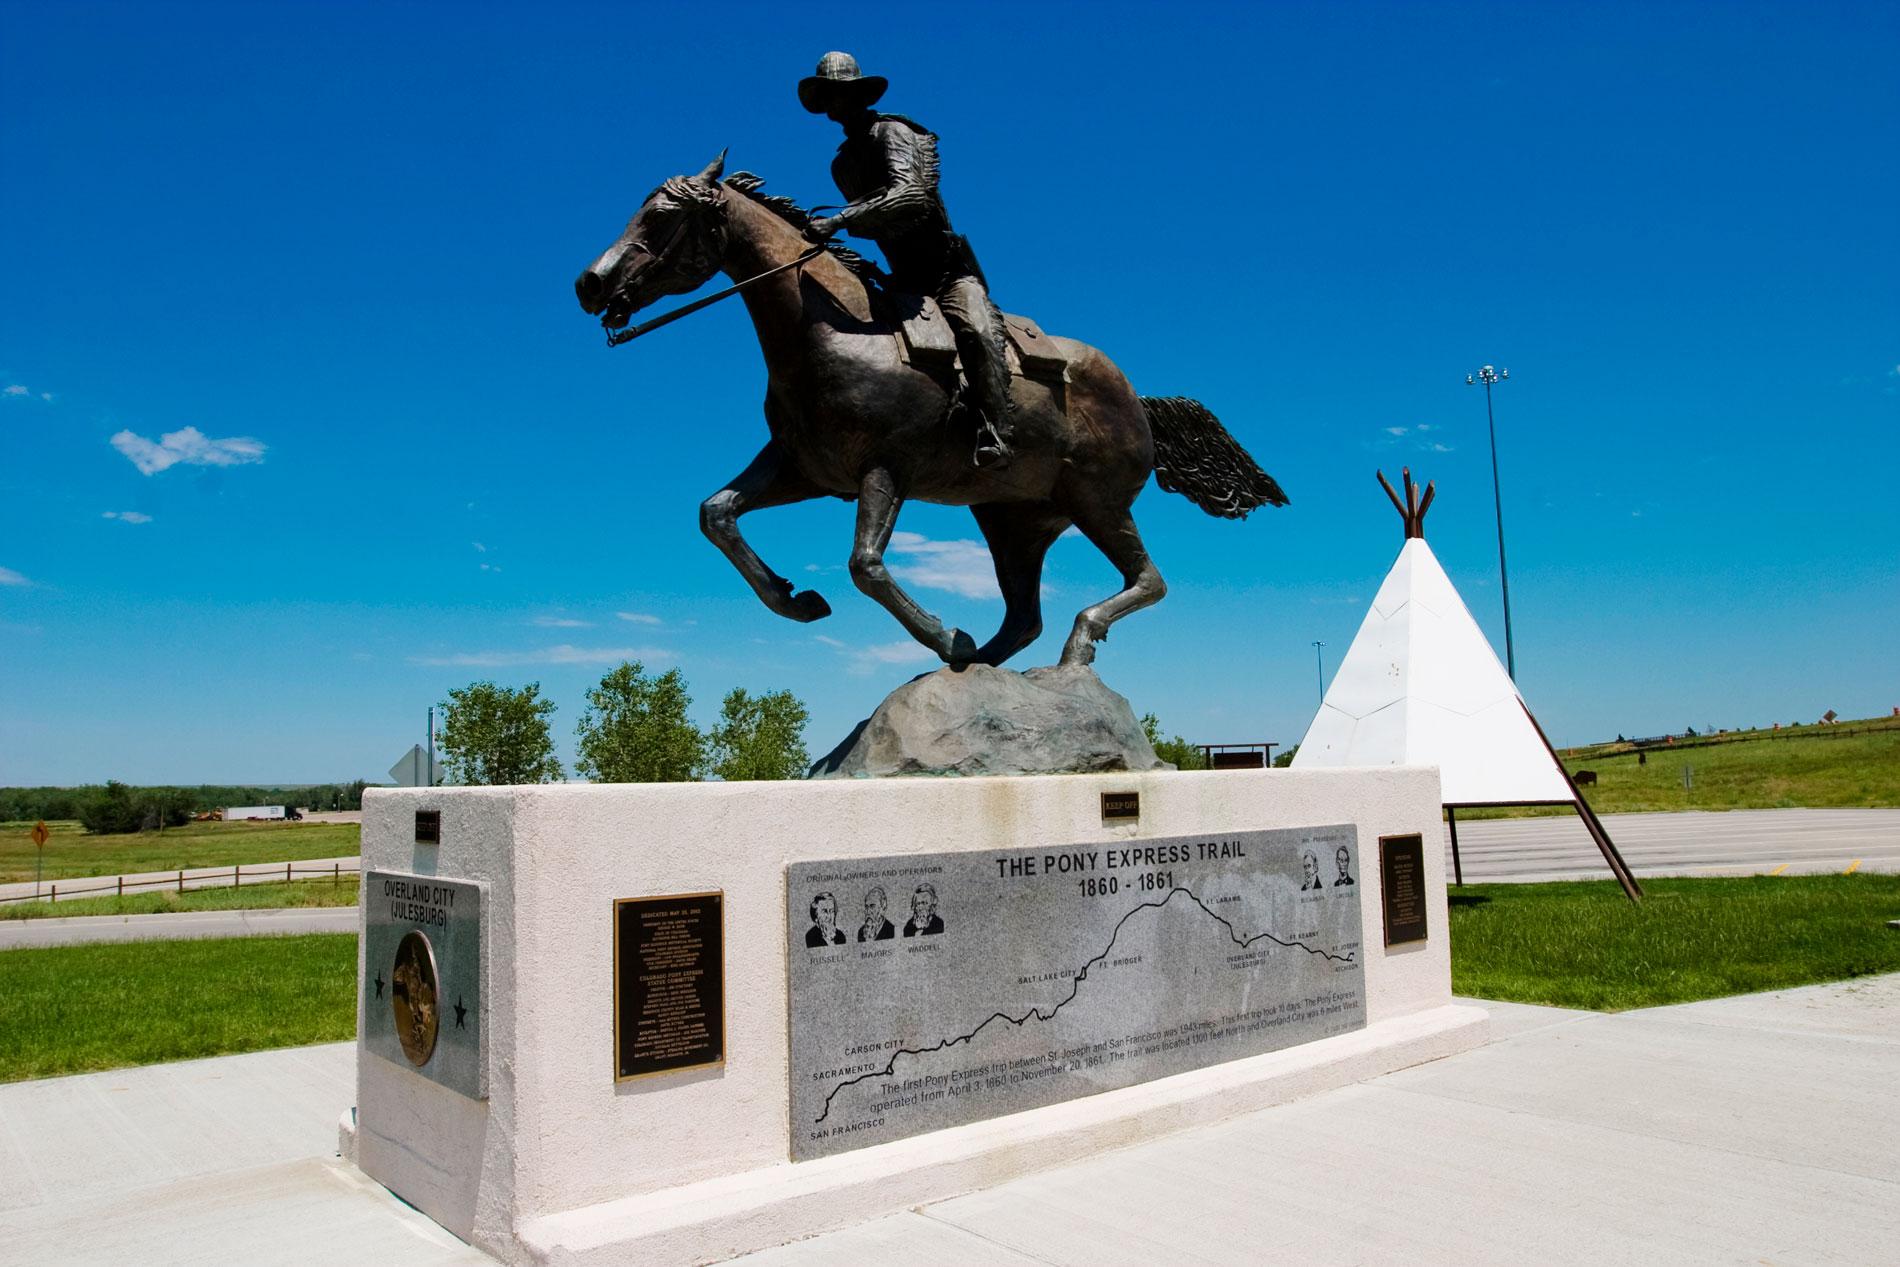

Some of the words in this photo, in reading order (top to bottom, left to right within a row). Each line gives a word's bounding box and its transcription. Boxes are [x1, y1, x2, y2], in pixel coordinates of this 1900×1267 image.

[996, 856, 1036, 878] THE
[1044, 853, 1098, 874] PONY
[1107, 844, 1190, 869] EXPRESS
[1197, 841, 1246, 861] TRAIL
[806, 873, 844, 883] ORIGINAL
[846, 871, 879, 881] OWNERS
[881, 869, 897, 878] AND
[899, 867, 943, 877] OPERATORS
[384, 880, 430, 903] OVERLAND
[433, 887, 456, 907] CITY
[1078, 876, 1118, 898] 1860
[1139, 871, 1173, 892] 1861
[391, 901, 447, 932] (JULESBURG)
[861, 950, 892, 960] MAJORS
[908, 944, 941, 954] WADDELL
[809, 955, 846, 965] RUSSELL
[1113, 956, 1143, 967] BRIDGER
[1018, 975, 1036, 985] SALT
[1038, 972, 1058, 982] LAKE
[1060, 969, 1077, 979] CITY
[844, 1043, 881, 1057] CARSON
[884, 1040, 904, 1049] CITY
[881, 1083, 899, 1095] The
[903, 1078, 922, 1091] first
[925, 1073, 949, 1087] Pony
[951, 1066, 989, 1082] Express
[992, 1061, 1007, 1074] trip
[1009, 1055, 1046, 1070] between
[1062, 1042, 1091, 1059] Joseph
[1093, 1041, 1108, 1053] and
[1109, 1038, 1124, 1049] San
[1125, 1031, 1161, 1046] Francisco
[1164, 1029, 1178, 1038] was
[1222, 1015, 1235, 1025] This
[1263, 1006, 1277, 1017] took
[1305, 998, 1316, 1007] The
[1332, 991, 1355, 1003] Express
[870, 1094, 917, 1114] operated
[920, 1090, 945, 1103] from
[947, 1083, 971, 1099] April
[986, 1073, 1007, 1089] 1860
[1010, 1074, 1019, 1084] to
[1021, 1064, 1066, 1081] November
[1110, 1051, 1125, 1062] The
[1127, 1047, 1142, 1060] trail
[1145, 1044, 1160, 1055] was
[1162, 1037, 1190, 1051] located
[1210, 1029, 1224, 1040] feet
[1226, 1024, 1246, 1037] North
[1247, 1021, 1260, 1032] and
[1260, 1015, 1291, 1029] Overland
[1291, 1012, 1305, 1023] City
[1307, 1009, 1319, 1019] was
[813, 1063, 875, 1081] SACRAMENTO
[810, 1129, 829, 1141] SAN
[832, 1117, 885, 1137] FRANCISCO
